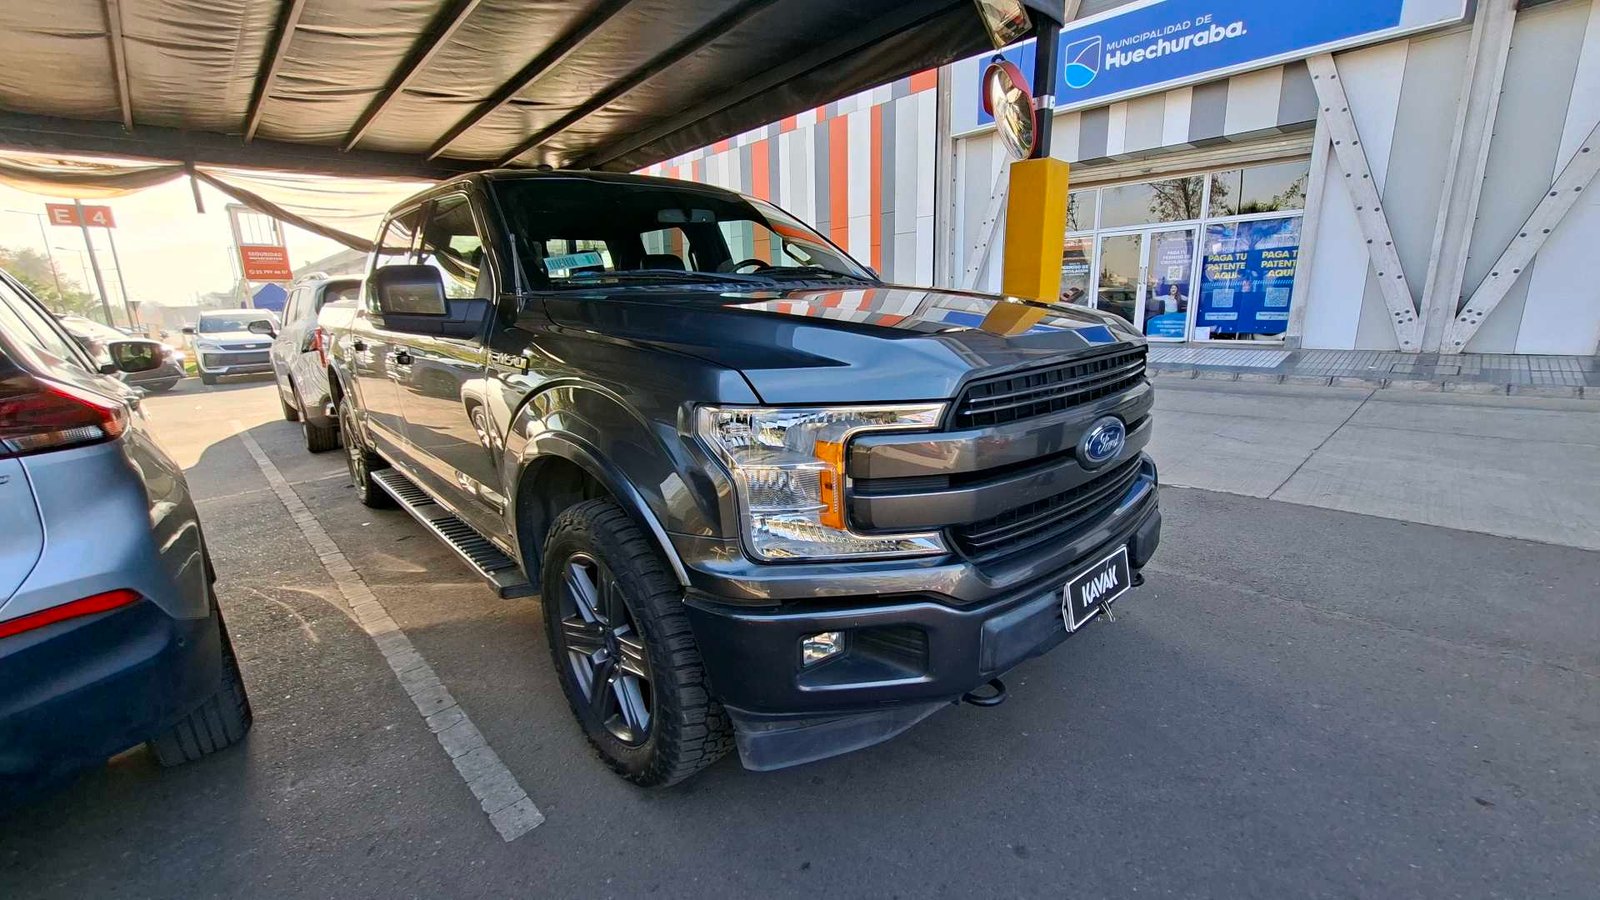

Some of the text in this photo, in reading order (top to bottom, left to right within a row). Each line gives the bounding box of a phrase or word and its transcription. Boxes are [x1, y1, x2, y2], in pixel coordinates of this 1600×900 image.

[1106, 13, 1213, 51] MUNICIPALIDAD DE
[54, 208, 107, 225] E 4
[1208, 252, 1248, 262] PAGA TU
[1262, 250, 1290, 258] PAGA
[1206, 262, 1246, 271] PATENTE
[1261, 260, 1297, 268] PATENT
[1097, 431, 1120, 455] Ford
[1081, 564, 1118, 608] KAVAK
